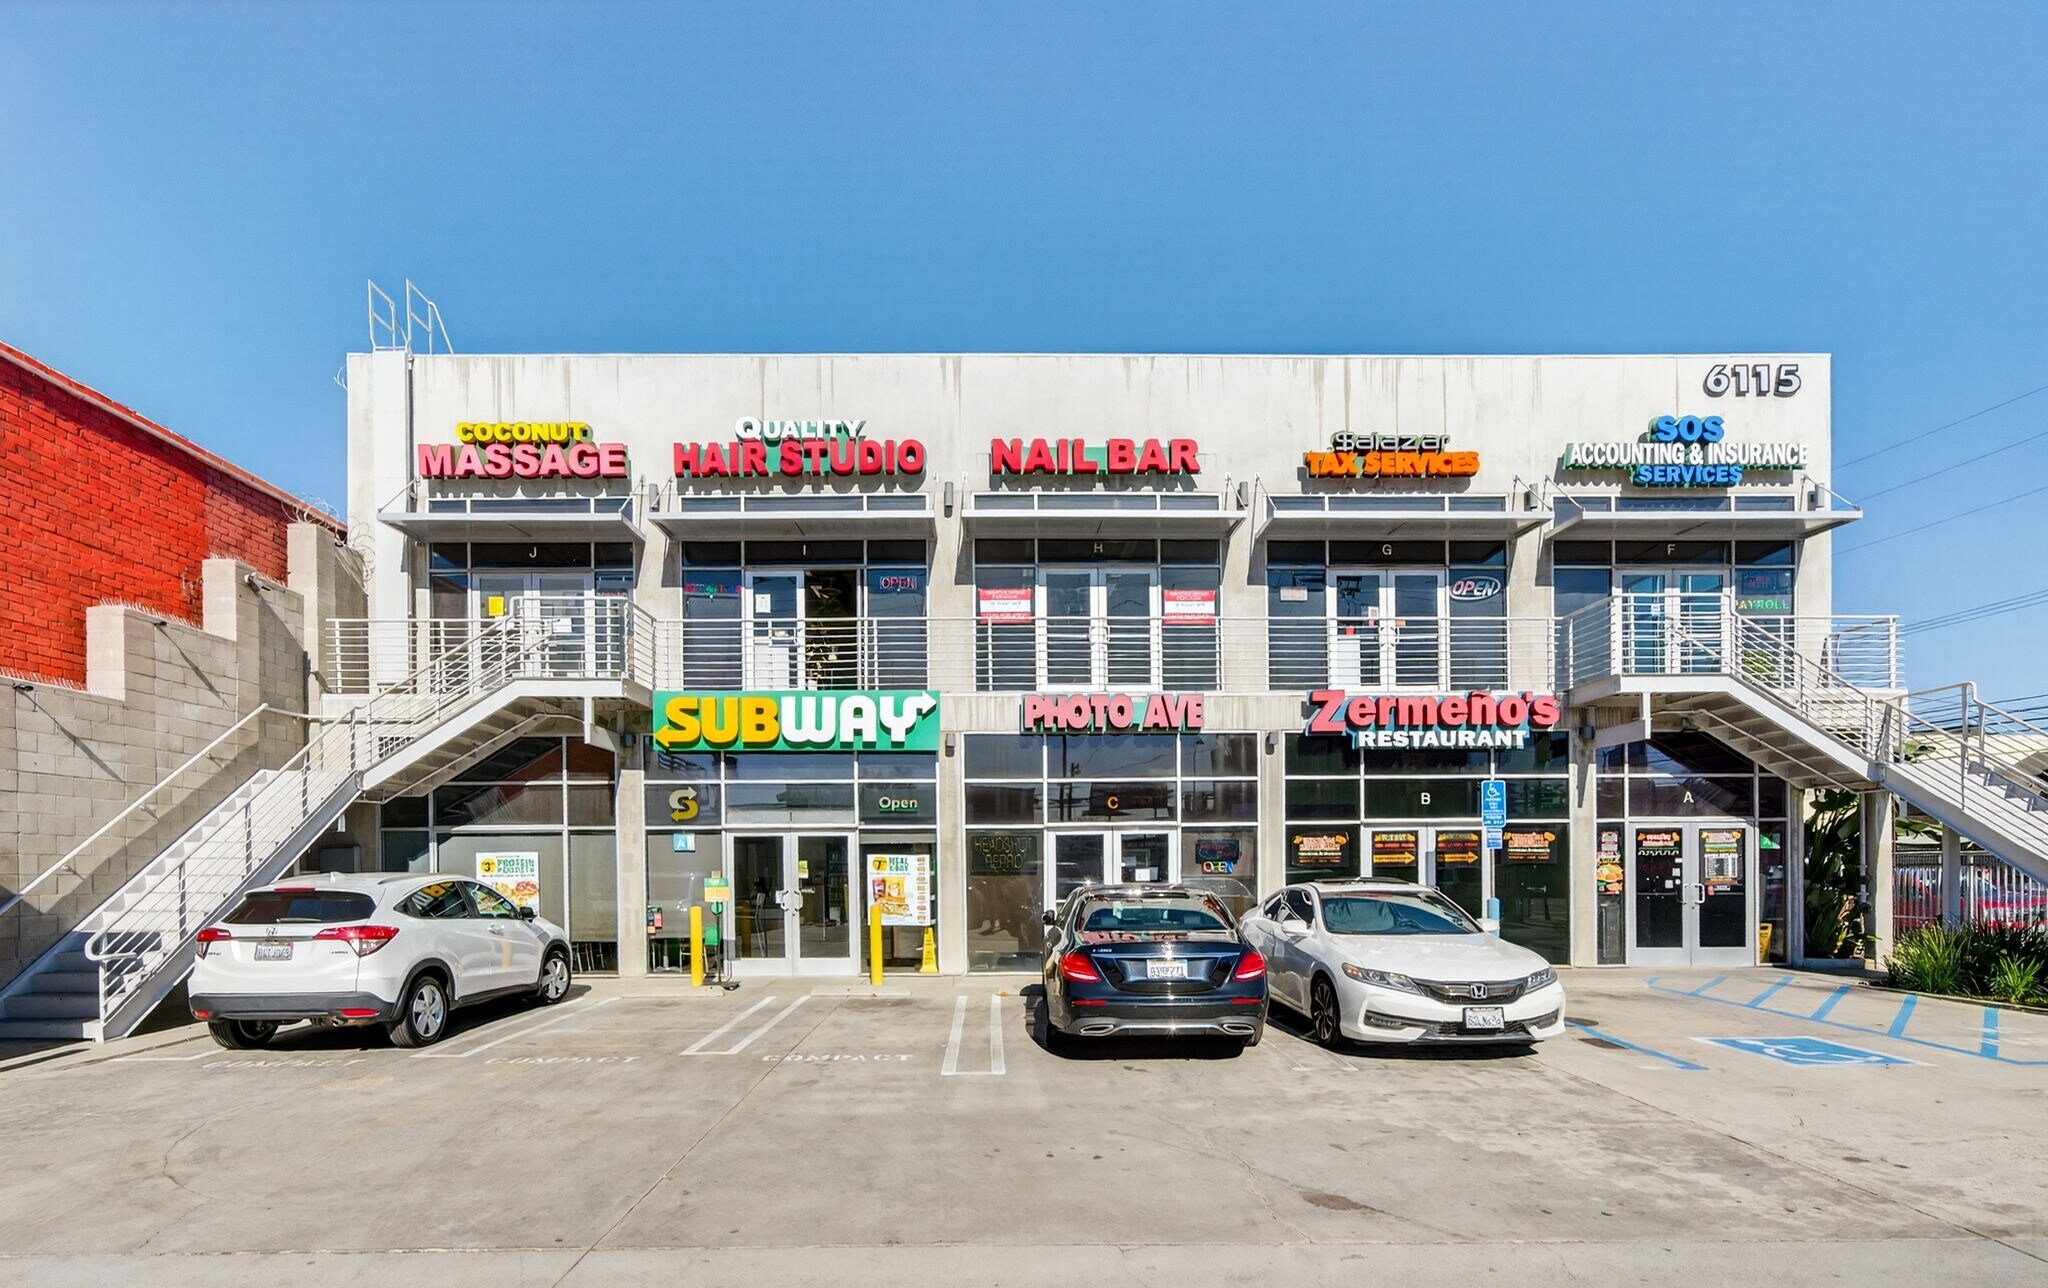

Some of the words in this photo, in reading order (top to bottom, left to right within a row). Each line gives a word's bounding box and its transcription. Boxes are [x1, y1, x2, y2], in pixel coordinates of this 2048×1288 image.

[1704, 364, 1801, 397] 6115
[455, 422, 588, 442] COCONUT
[735, 416, 863, 439] QUALITY
[1656, 415, 1725, 442] SOS
[418, 443, 628, 478] MASSAGE
[673, 442, 769, 477] HAIR
[780, 439, 925, 476] STUDIO
[991, 438, 1099, 474] NAIL
[1107, 438, 1200, 474] BAR
[1570, 443, 1685, 464] ACCOUNTING
[1689, 443, 1704, 465] &
[1708, 443, 1808, 464] INSURANCE
[1306, 452, 1359, 477] TAX
[1364, 451, 1480, 477] SERVICES
[1637, 466, 1743, 484] SERVICES
[529, 546, 537, 558] J
[1093, 542, 1103, 553] H
[1382, 544, 1392, 556] G
[1667, 544, 1675, 556] F
[881, 576, 916, 590] OPEN
[1452, 579, 1495, 597] OPEN
[654, 692, 937, 748] SUBWAY
[1024, 694, 1133, 729] PHOTO
[1143, 693, 1204, 728] AVE
[1309, 689, 1561, 733] Zermeño's
[1358, 730, 1527, 747] RESTAURANT
[879, 796, 918, 811] Open
[1107, 796, 1119, 809] C
[1420, 792, 1431, 805] B
[1683, 791, 1694, 803] A
[677, 840, 686, 849] A
[761, 1053, 915, 1063] COMPACT
